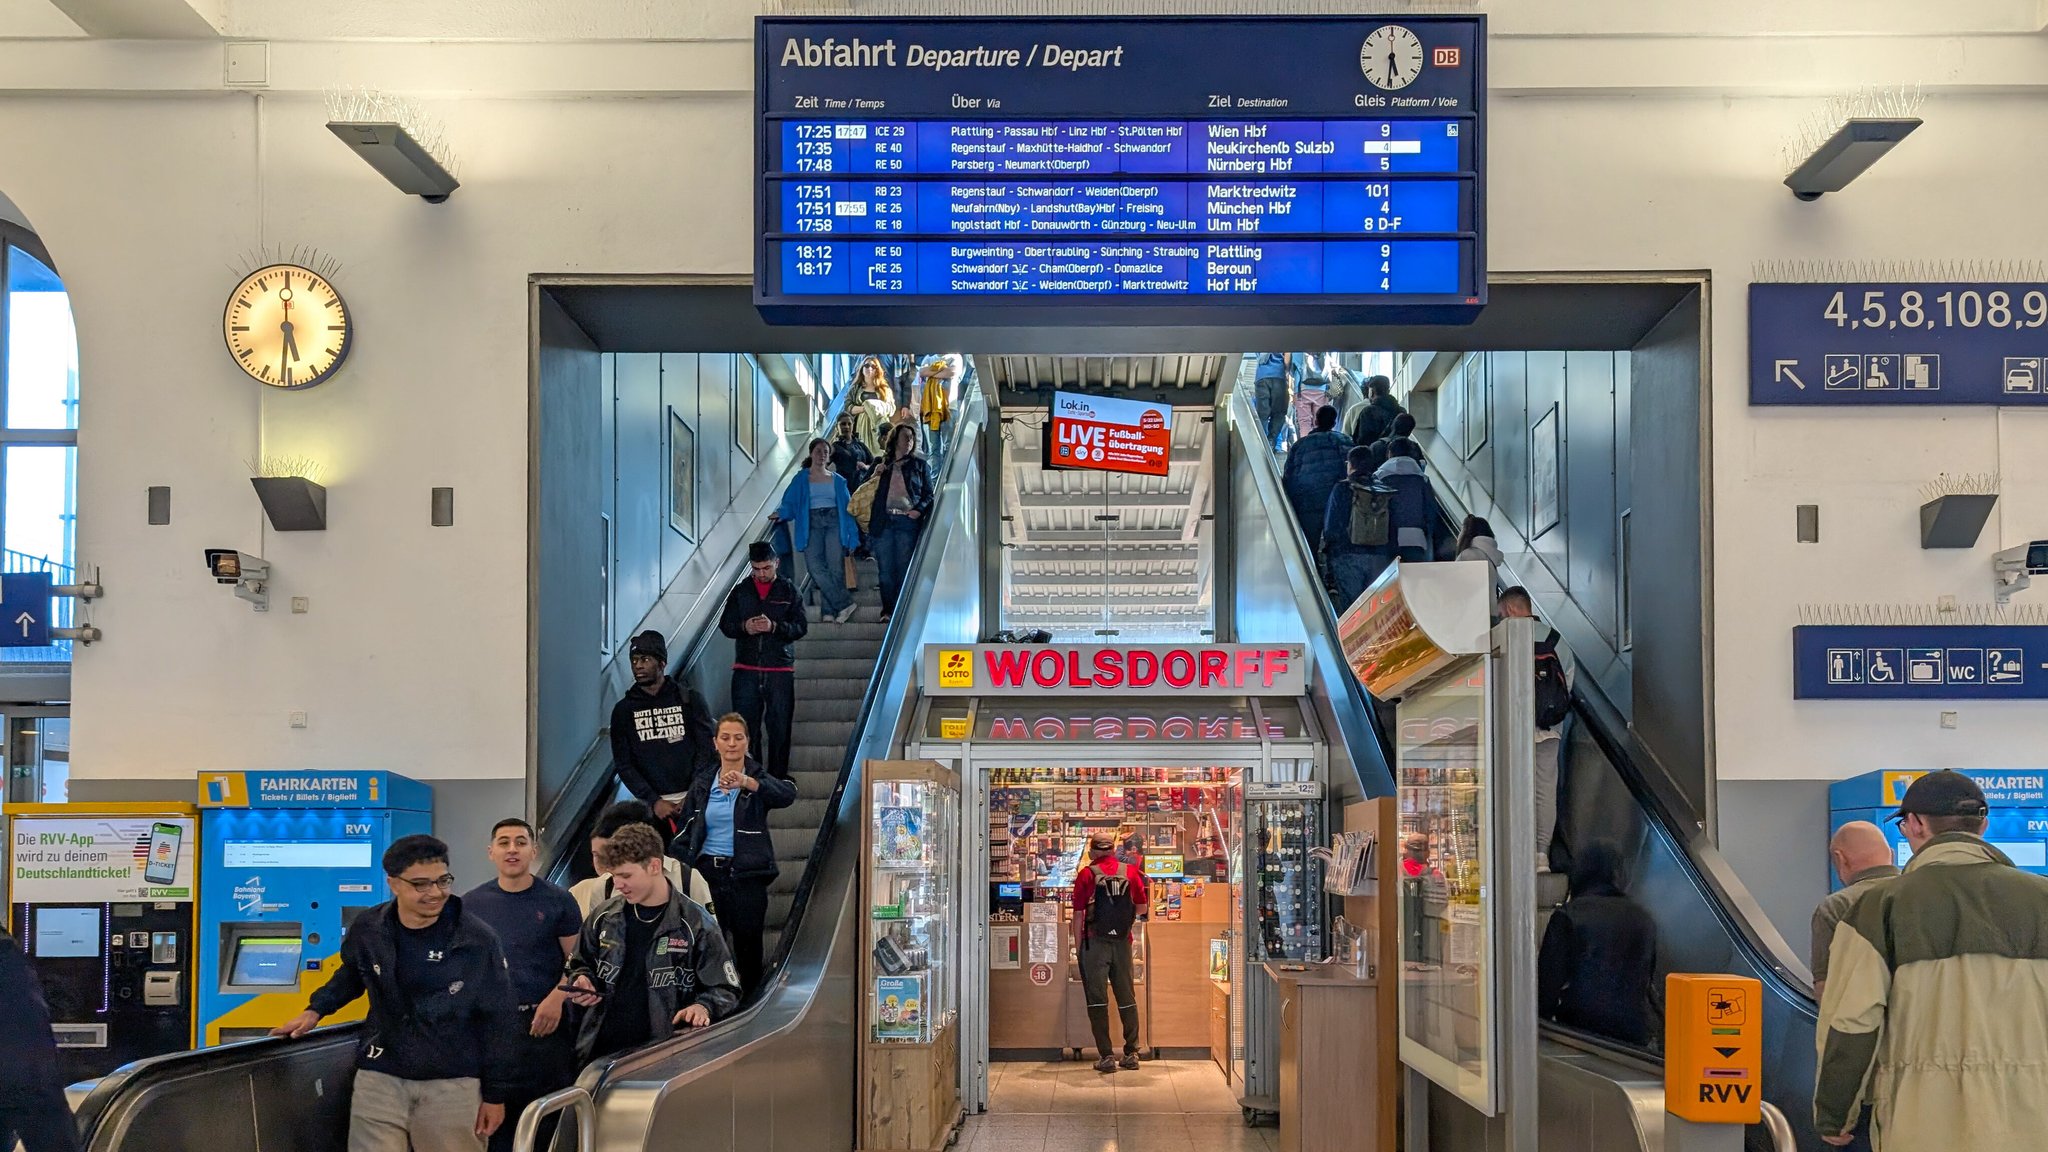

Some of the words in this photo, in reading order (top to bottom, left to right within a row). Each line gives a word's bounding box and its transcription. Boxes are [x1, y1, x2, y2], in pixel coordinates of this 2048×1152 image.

[780, 38, 896, 66] Abfahrt
[906, 44, 1020, 71] Departure
[1026, 45, 1038, 67] /
[1042, 44, 1124, 71] Depart
[1436, 51, 1457, 64] DB
[795, 96, 818, 108] Zeit
[824, 98, 846, 108] Time
[848, 98, 854, 108] /
[854, 98, 885, 111] Temps
[952, 94, 980, 108] Über
[986, 98, 1000, 108] Via
[1208, 95, 1232, 108] Ziel
[1238, 98, 1288, 108] Destination
[1354, 94, 1386, 107] Gleis
[1391, 97, 1430, 108] Platform
[1431, 97, 1437, 108] /
[1438, 97, 1458, 107] Voie
[796, 126, 832, 139] 17:25
[838, 128, 865, 137] 17:47
[876, 127, 889, 137] ICE
[892, 127, 905, 137] 29
[952, 126, 994, 138] Plattling
[1004, 126, 1039, 137] Passau
[1042, 126, 1058, 137] Hbf
[1069, 126, 1090, 137] Linz
[1091, 126, 1108, 137] Hbf
[1118, 126, 1164, 137] St.Pölten
[1166, 126, 1182, 137] Hbf
[1208, 125, 1240, 138] Wien
[1244, 125, 1267, 138] Hbf
[1381, 125, 1390, 137] 9
[796, 142, 832, 155] 17:35
[876, 144, 887, 153] RE
[890, 144, 902, 153] 40
[952, 143, 1006, 155] Regenstauf
[1017, 143, 1102, 153] Maxhütte-Haidhof
[1114, 142, 1172, 153] Schwandorf
[1208, 142, 1290, 156] Neukirchen(b
[1295, 142, 1334, 155] Sulzb)
[1383, 141, 1390, 154] 4
[796, 159, 832, 172] 17:48
[876, 160, 887, 170] RE
[890, 160, 902, 170] 50
[952, 160, 994, 171] Parsberg
[1005, 160, 1090, 171] Neumarkt(Oberpf)
[1208, 158, 1265, 173] Nürnberg
[1270, 158, 1292, 171] Hbf
[1380, 158, 1390, 170] 5
[796, 186, 832, 199] 17:51
[876, 187, 887, 197] RB
[890, 187, 902, 197] 23
[952, 186, 1006, 198] Regenstauf
[1017, 186, 1074, 197] Schwandorf
[1086, 186, 1158, 198] Weiden(Oberpf)
[1208, 185, 1296, 198] Marktredwitz
[1365, 185, 1390, 197] 101
[796, 202, 832, 215] 17:51
[838, 204, 865, 213] 17:55
[876, 204, 887, 213] RE
[890, 204, 902, 213] 25
[952, 203, 1020, 214] Neufahrn(Nby)
[1031, 203, 1116, 214] Landshut(Bay)Hbf
[1126, 202, 1164, 214] Freising
[1208, 201, 1265, 214] München
[1269, 201, 1292, 214] Hbf
[1381, 201, 1390, 214] 4
[796, 219, 832, 232] 17:58
[876, 220, 887, 230] RE
[890, 220, 902, 230] 18
[952, 219, 1001, 231] Ingolstadt
[1004, 219, 1020, 230] Hbf
[1032, 219, 1090, 230] Donauwörth
[1101, 219, 1146, 231] Günzburg
[1157, 219, 1196, 230] Neu-Ulm
[1208, 218, 1232, 231] Ulm
[1237, 218, 1260, 231] Hbf
[1364, 218, 1374, 230] 8
[1378, 218, 1402, 230] D-F
[796, 246, 832, 259] 18:12
[876, 247, 887, 257] RE
[890, 247, 902, 257] 50
[952, 246, 1014, 258] Burgweinting
[1024, 246, 1090, 258] Obertraubling
[1100, 246, 1142, 258] Sünching
[1154, 246, 1199, 258] Straubing
[1208, 245, 1262, 260] Plattling
[1381, 245, 1390, 257] 9
[796, 263, 832, 275] 18:17
[876, 264, 887, 273] RE
[890, 264, 902, 273] 25
[952, 263, 1008, 273] Schwandorf
[1039, 263, 1104, 275] Cham(Oberpf)
[1114, 263, 1162, 273] Domazlice
[1208, 262, 1252, 275] Beroun
[1381, 261, 1390, 274] 4
[876, 280, 887, 290] RE
[890, 280, 902, 290] 23
[952, 280, 1008, 290] Schwandorf
[1039, 280, 1112, 292] Weiden(Oberpf)
[1124, 279, 1189, 290] Marktredwitz
[1208, 278, 1230, 292] Hof
[1235, 278, 1258, 292] Hbf
[1381, 278, 1390, 291] 4
[1061, 399, 1089, 412] Lok.in
[1058, 422, 1106, 447] LIVE
[1110, 429, 1145, 440] Fußball-
[1109, 440, 1164, 455] übertragung
[984, 650, 1290, 688] WOLSDORFF
[1950, 666, 1975, 680] WC
[634, 713, 684, 730] KICKER
[637, 725, 686, 742] VILZING
[260, 778, 358, 790] FAHRKARTEN
[1970, 777, 2044, 789] RKARTEN
[328, 794, 357, 802] Biglietti
[346, 824, 371, 834] RVV
[17, 834, 36, 845] Die
[40, 833, 94, 847] RVV-App
[17, 851, 43, 862] wird
[48, 853, 60, 862] zu
[64, 850, 108, 862] deinem
[149, 860, 174, 868] D-TICKET
[17, 866, 131, 879] Deutschlandticket!
[367, 1045, 383, 1059] 17
[1700, 1084, 1752, 1103] RVV
